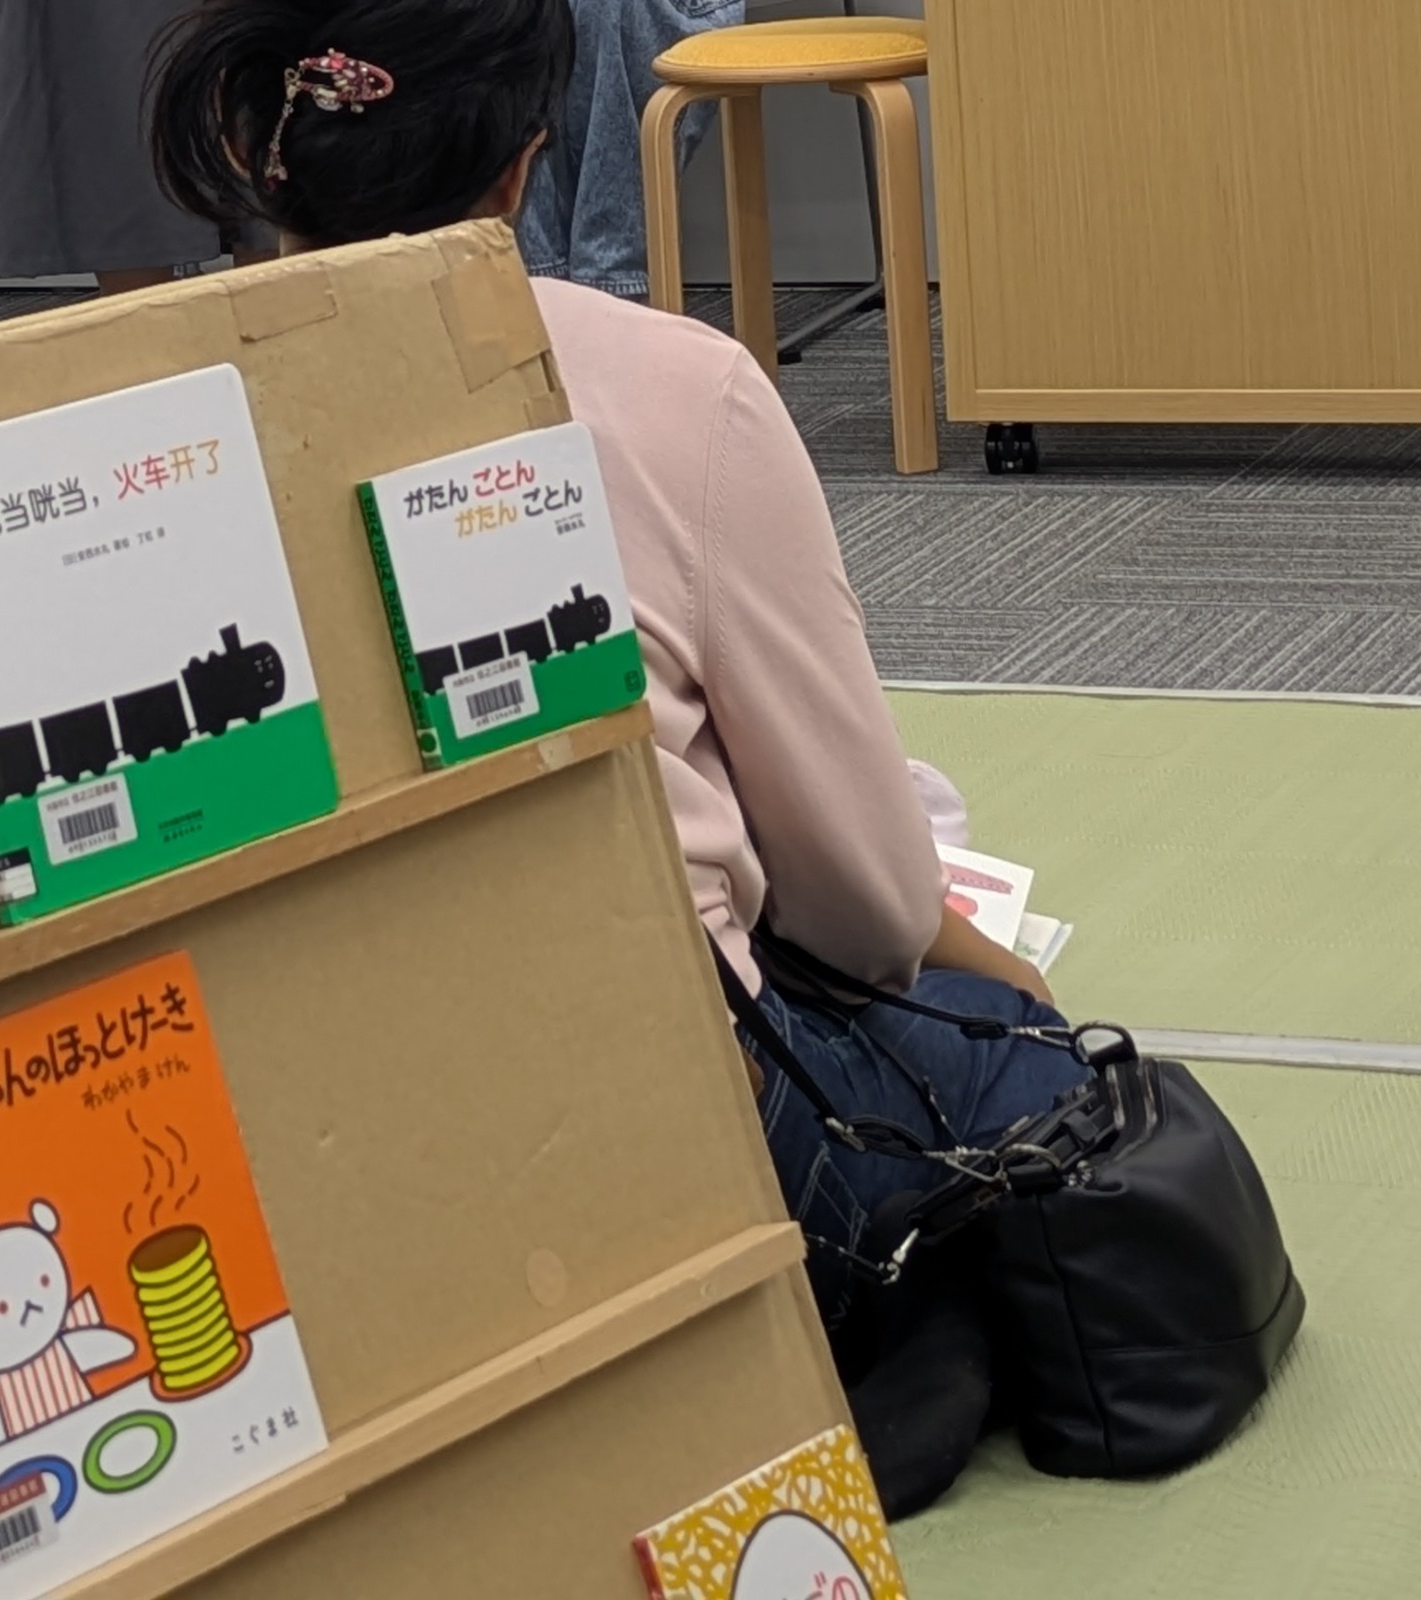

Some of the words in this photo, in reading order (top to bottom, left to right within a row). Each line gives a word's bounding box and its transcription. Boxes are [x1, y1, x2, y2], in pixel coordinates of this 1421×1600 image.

[403, 479, 468, 518] がたん
[473, 460, 536, 498] ごとん
[454, 501, 518, 539] がたん
[522, 479, 583, 518] ごとん
[232, 1406, 300, 1454] こぐま社
